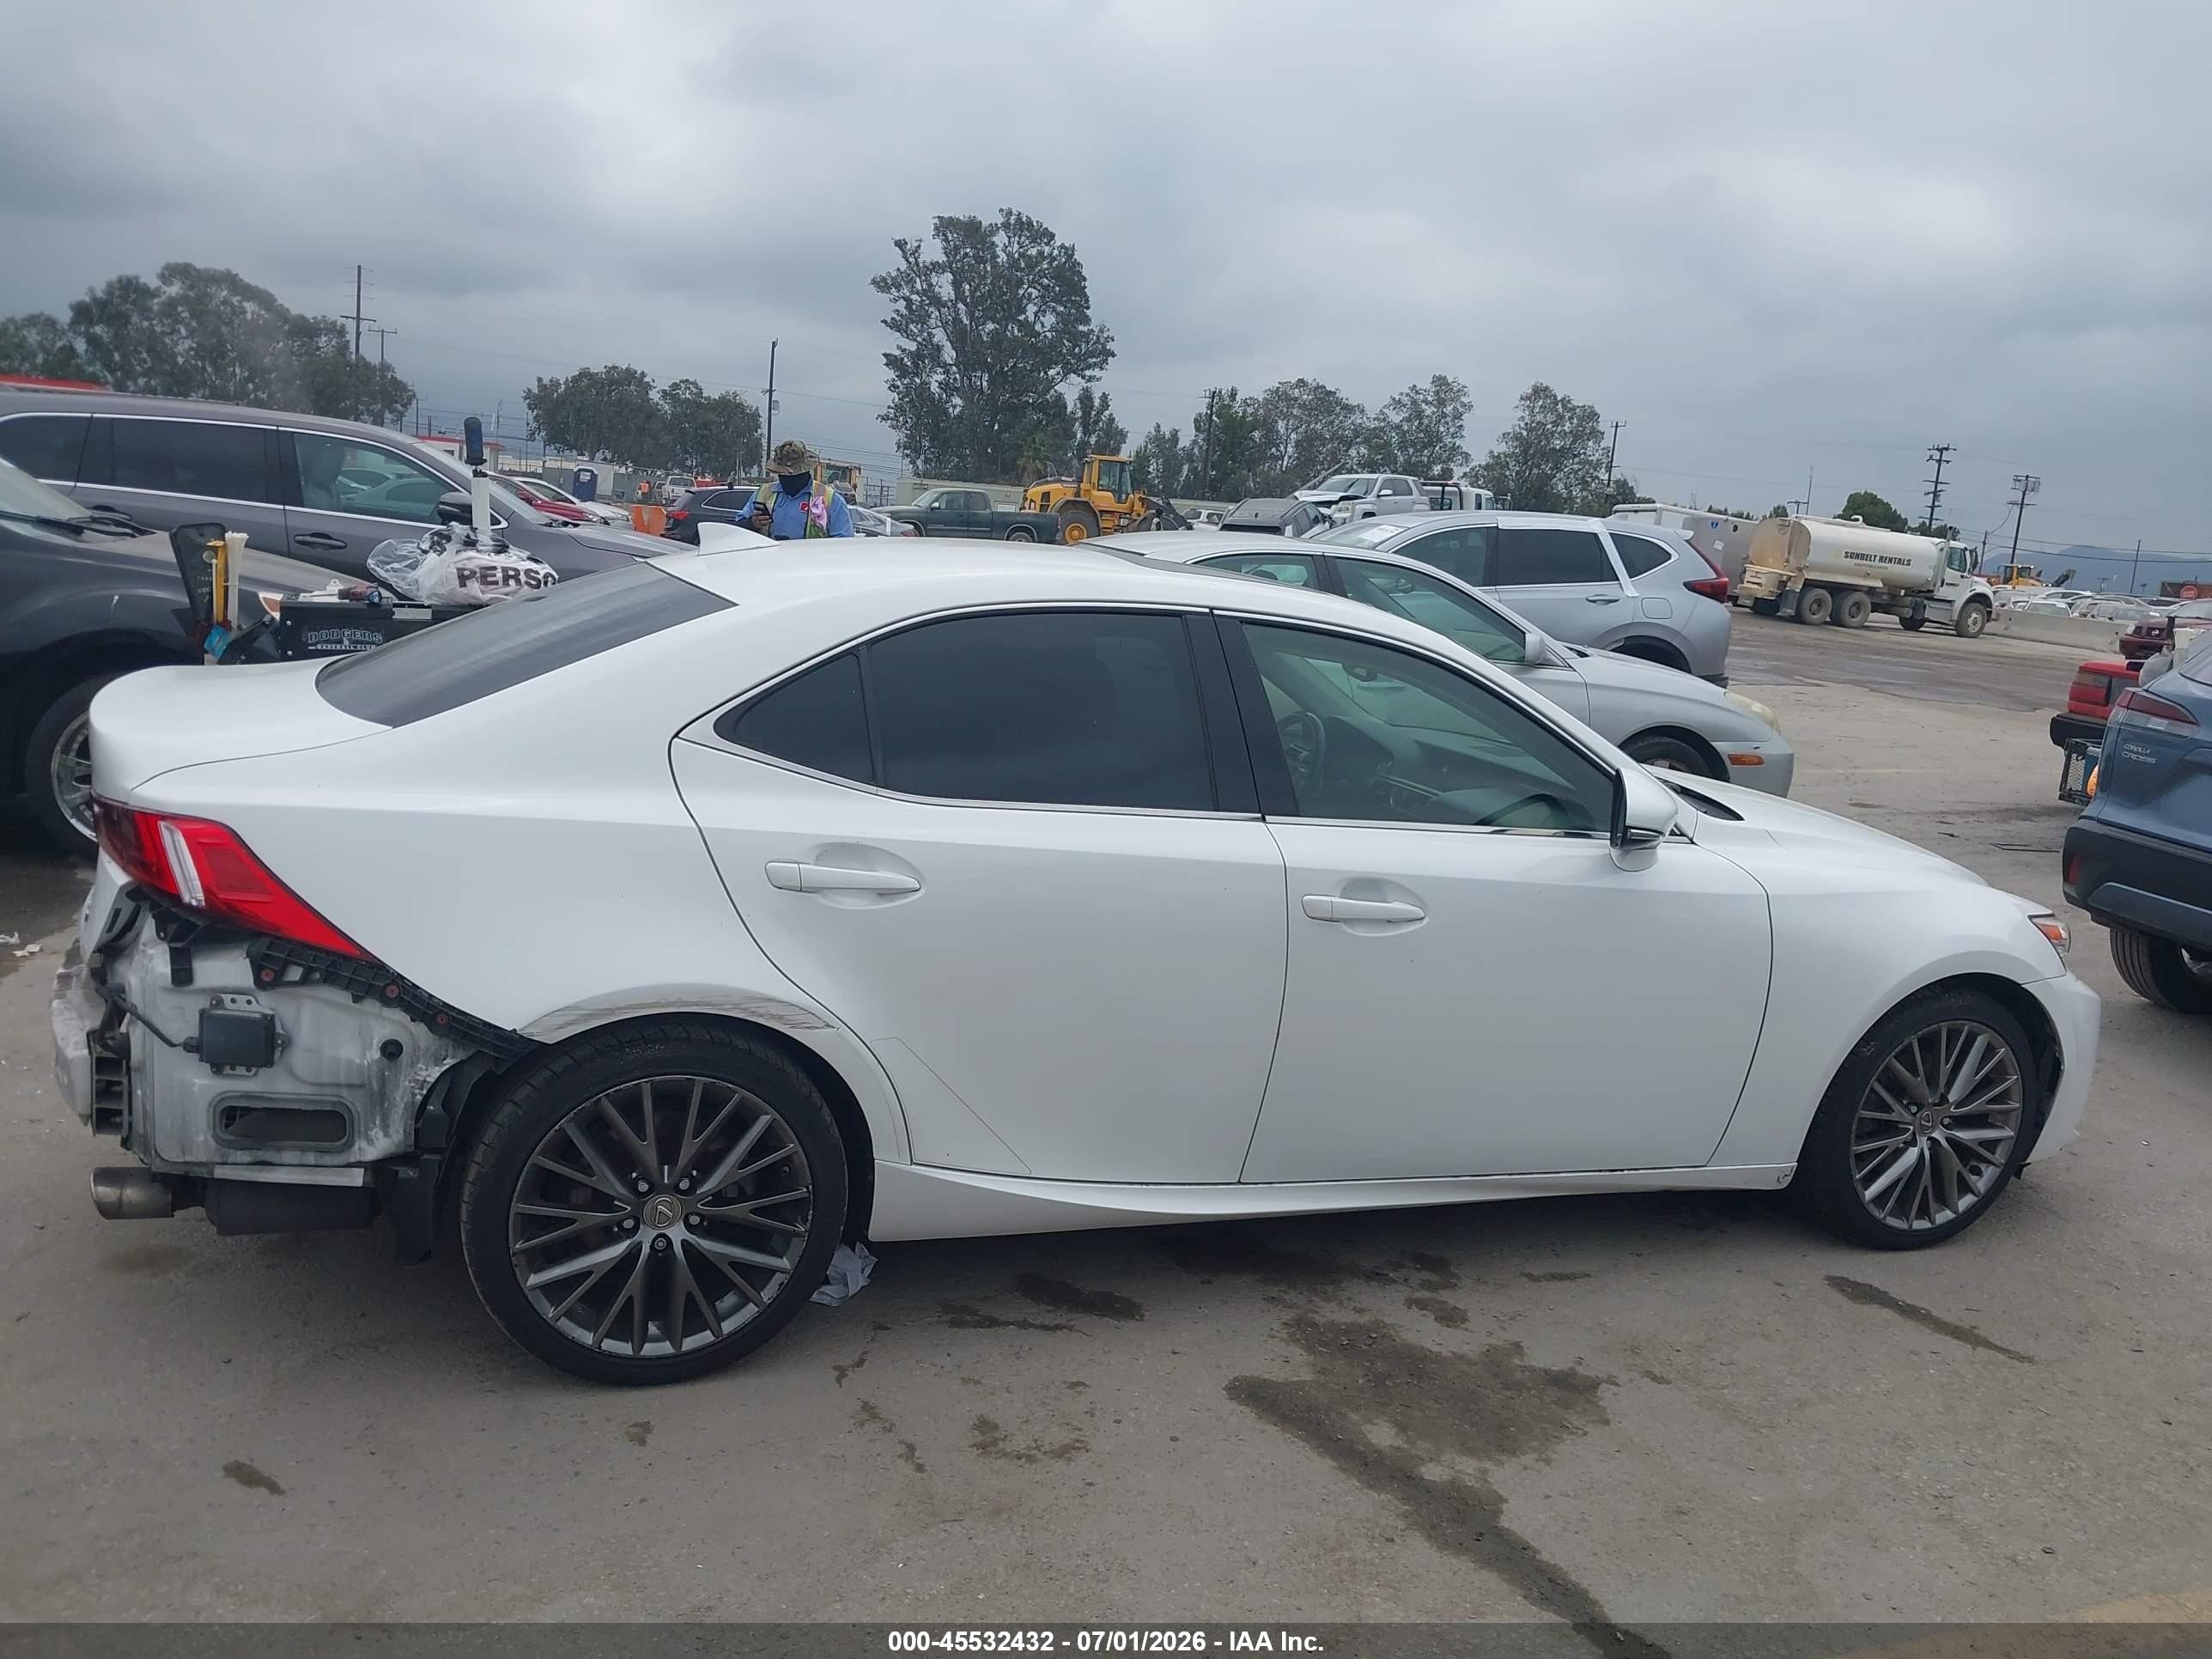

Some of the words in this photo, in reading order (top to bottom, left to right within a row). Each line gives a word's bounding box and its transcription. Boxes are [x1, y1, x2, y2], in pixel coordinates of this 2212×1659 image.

[1844, 550, 1878, 562] SUNBELT
[1878, 556, 1912, 567] RENTALS
[308, 629, 383, 644] DODGERS
[2124, 743, 2151, 754] COROLLA
[2122, 751, 2157, 764] CROSS
